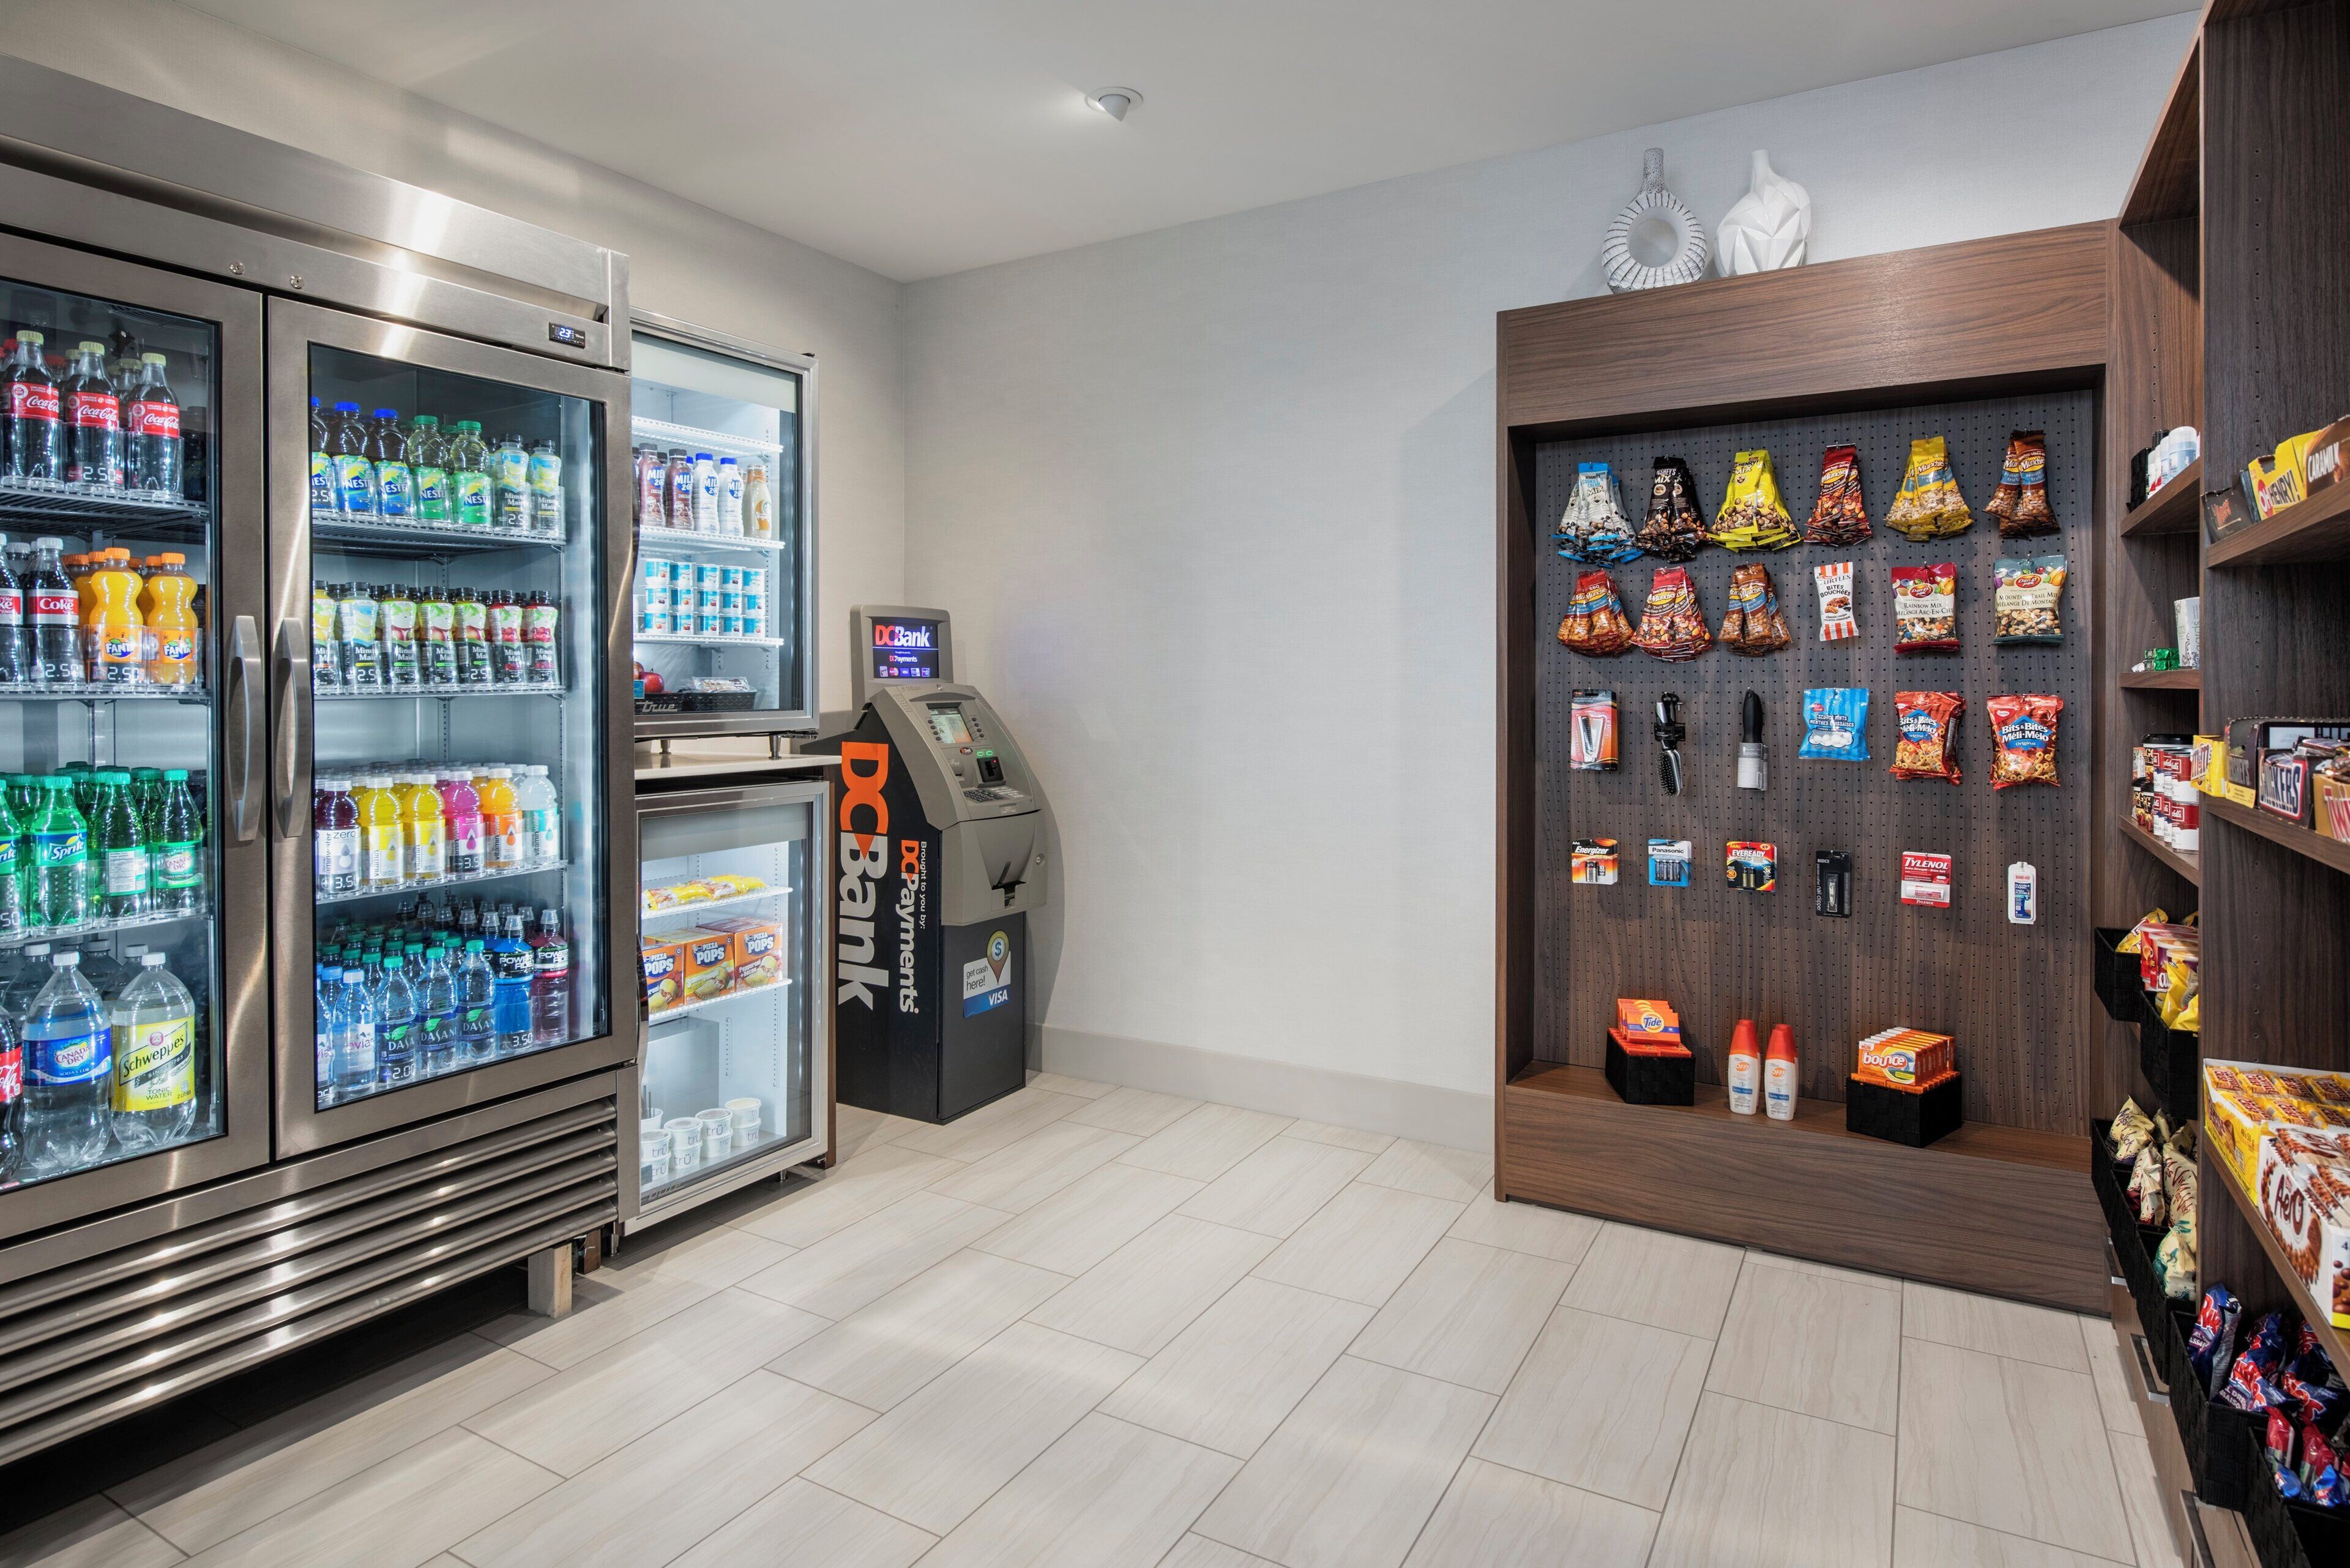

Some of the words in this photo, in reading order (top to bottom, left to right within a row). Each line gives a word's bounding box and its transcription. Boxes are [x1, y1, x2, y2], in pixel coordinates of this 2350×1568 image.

[80, 405, 118, 422] Coca-Cola
[2308, 442, 2340, 482] CARAMILK
[2258, 487, 2272, 513] OH
[2268, 469, 2301, 506] HENRY!
[40, 599, 74, 610] Coke
[875, 625, 930, 647] DCBank
[1918, 716, 1937, 726] Bites
[2002, 724, 2020, 734] Bits
[2024, 722, 2049, 733] Bites
[52, 841, 84, 859] Sprite
[1575, 846, 1610, 854] Energizer
[1904, 857, 1949, 869] TYLENOL
[838, 741, 889, 1011] DCBank
[920, 882, 927, 891] to
[896, 840, 919, 1012] DCPayments
[754, 931, 767, 940] PIZZA
[748, 936, 774, 954] POPS
[651, 953, 667, 962] PIZZA
[696, 947, 725, 965] POPS
[645, 958, 674, 976] POPS
[966, 969, 975, 979] get
[976, 965, 988, 976] cash
[966, 978, 986, 991] here!
[988, 989, 1008, 1006] VISA
[1643, 1017, 1662, 1028] Tide
[513, 1032, 532, 1047] 3.50
[56, 1047, 91, 1062] CANADA
[67, 1054, 84, 1066] DRY
[124, 1035, 184, 1077] Schweppes
[1863, 1051, 1906, 1066] bounce
[393, 1064, 416, 1080] 2.00
[146, 1092, 173, 1100] WATER
[707, 1125, 723, 1137] trü
[2274, 1174, 2303, 1235] Aero
